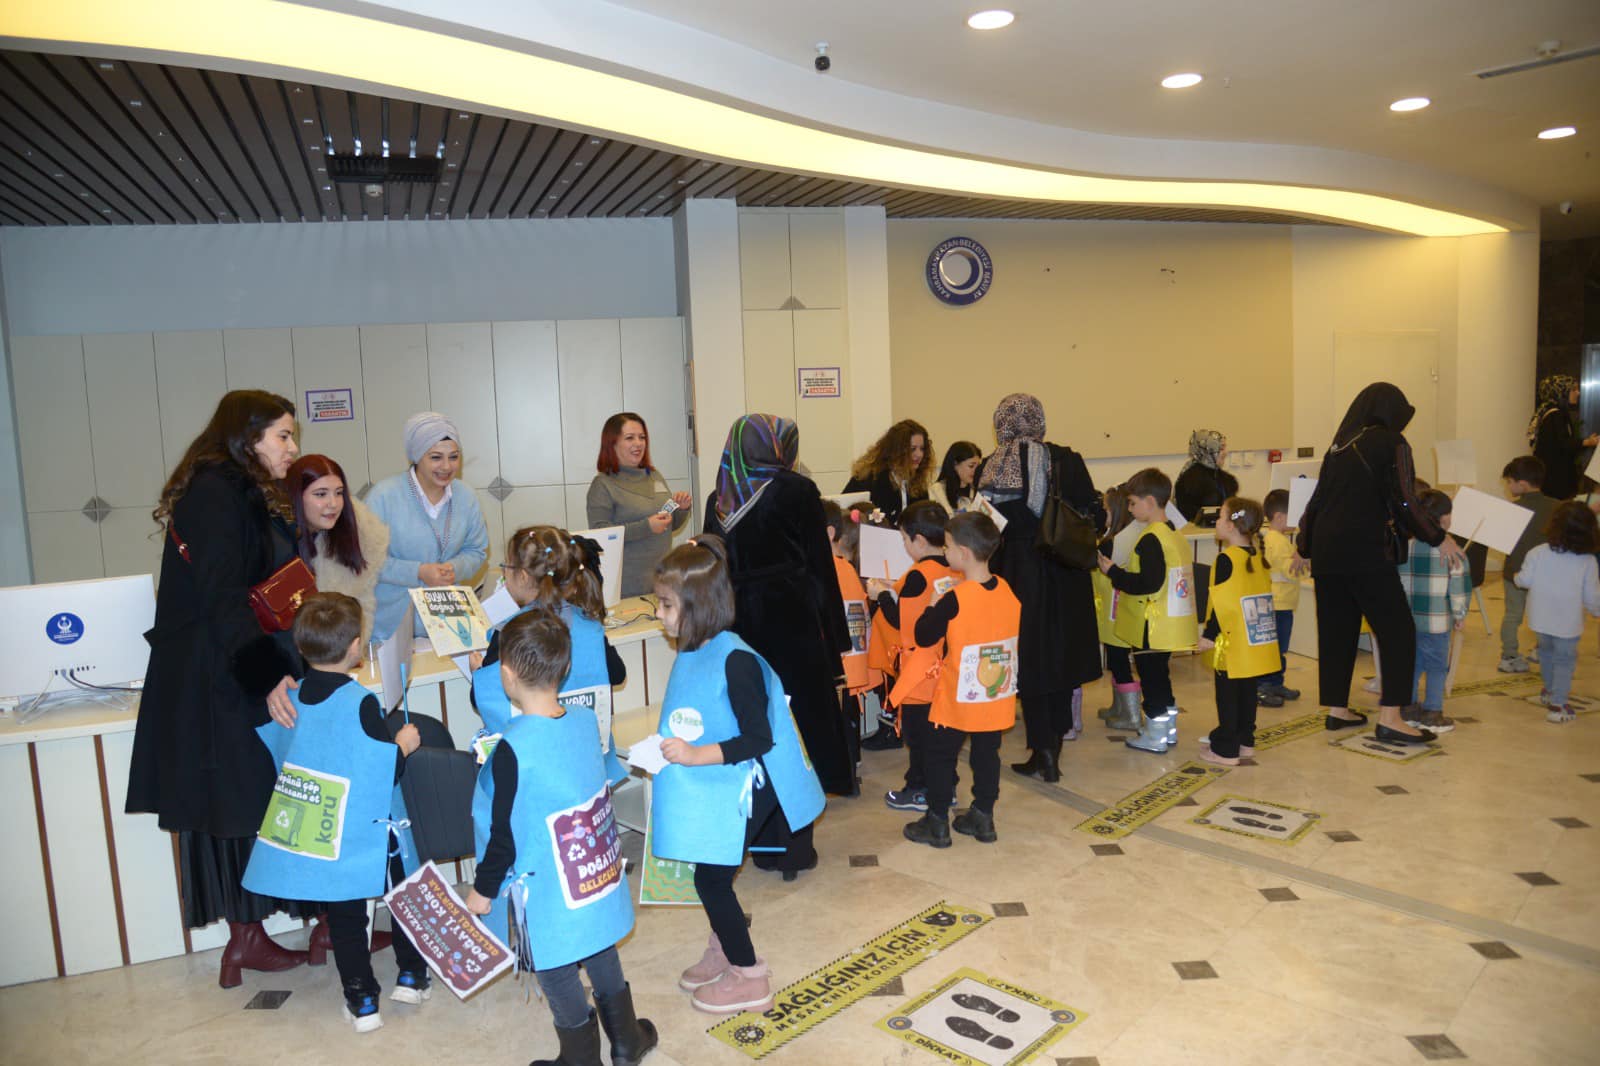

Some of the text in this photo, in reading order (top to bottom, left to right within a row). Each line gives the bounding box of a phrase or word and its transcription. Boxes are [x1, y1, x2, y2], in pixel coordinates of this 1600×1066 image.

[303, 781, 320, 794] çöp
[309, 794, 321, 804] at
[314, 795, 338, 844] koru
[418, 883, 447, 917] KORU
[397, 901, 445, 960] SUYU AZALT
[763, 952, 886, 1022] SAĞLIĞINIZ
[875, 928, 927, 958] İÇİN
[916, 1036, 963, 1061] DİKKAT
